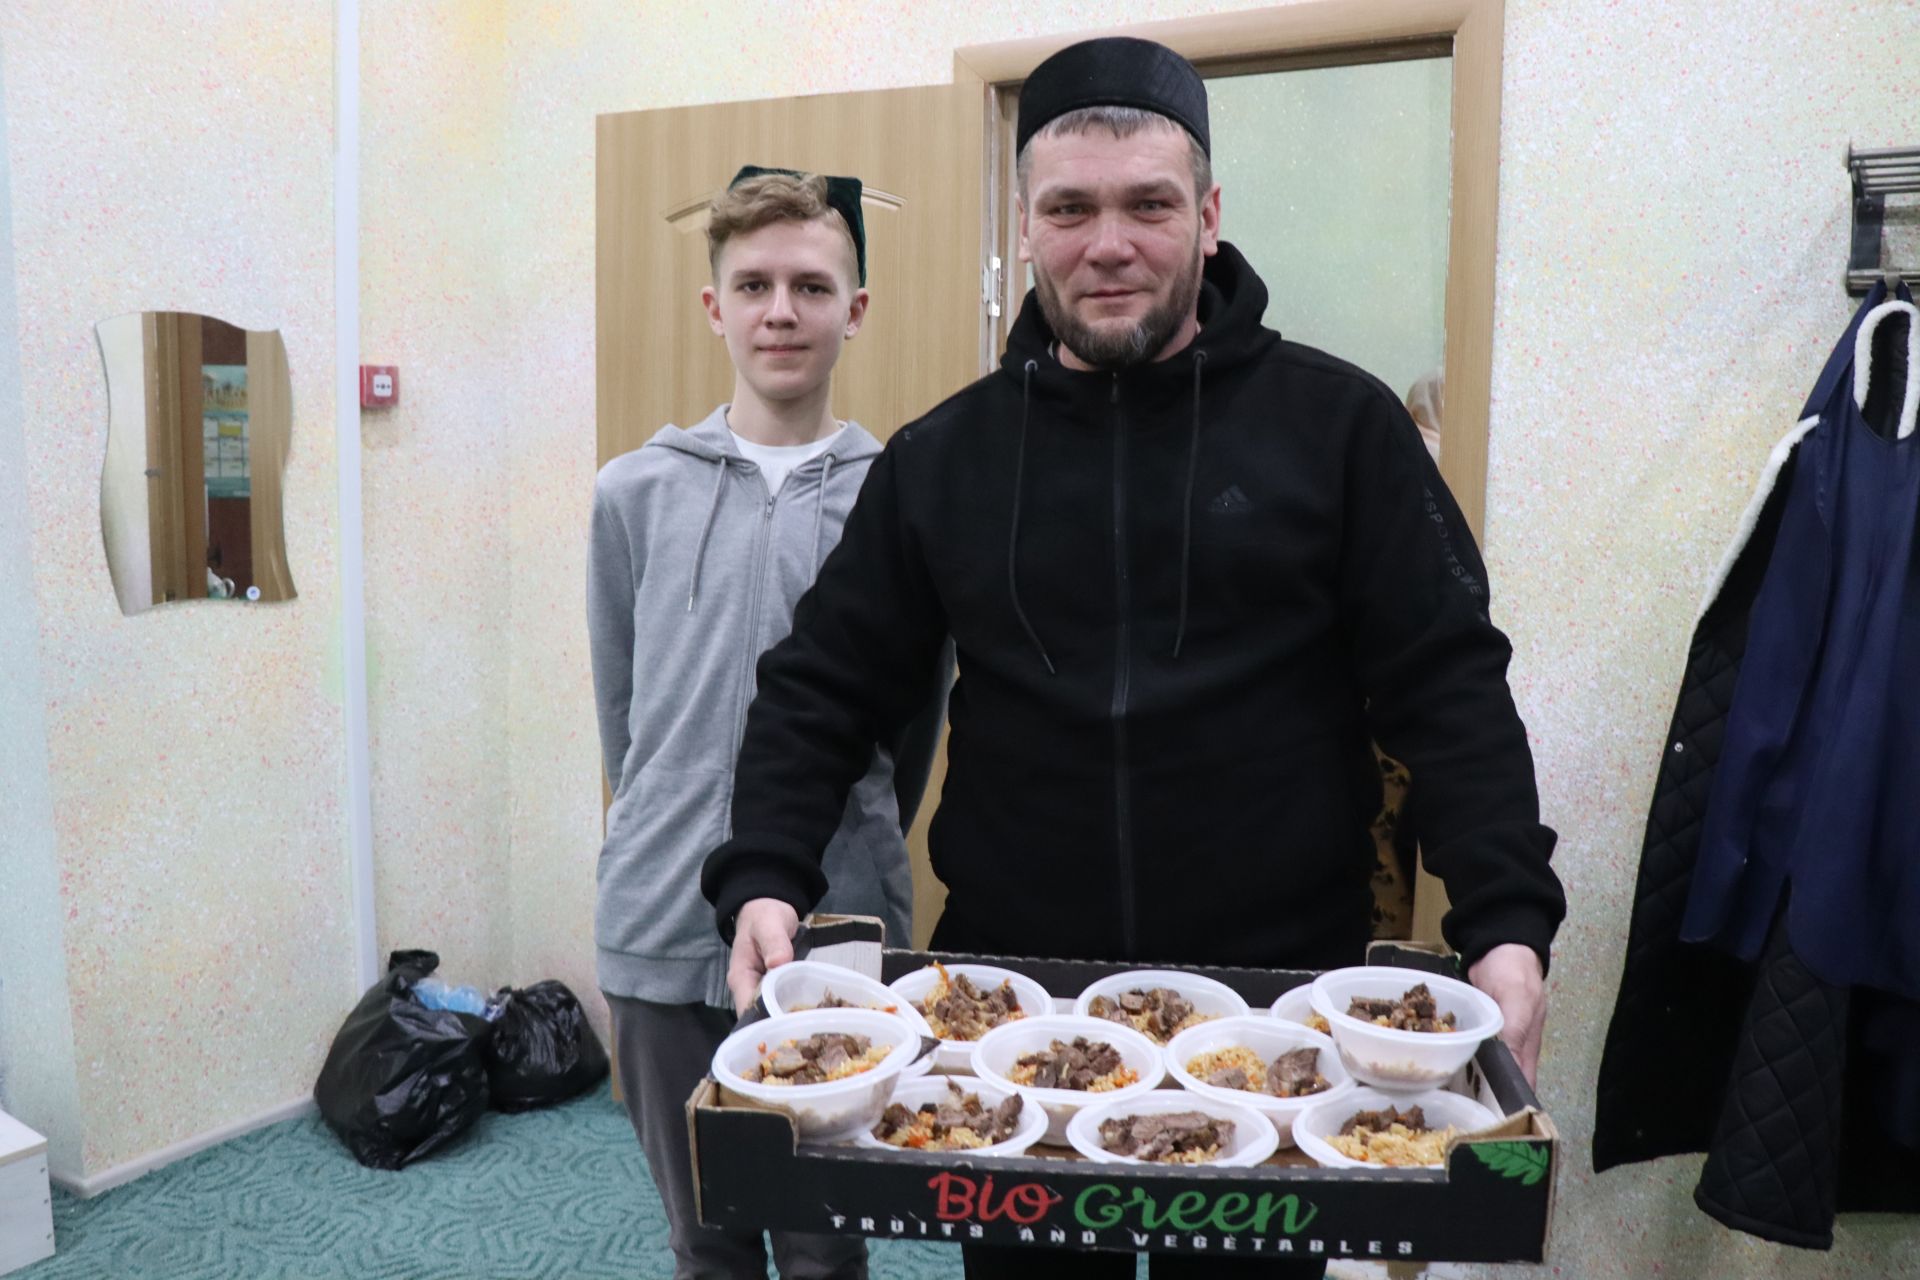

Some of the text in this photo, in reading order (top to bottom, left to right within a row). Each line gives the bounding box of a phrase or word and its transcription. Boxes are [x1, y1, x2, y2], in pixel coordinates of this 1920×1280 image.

[927, 1171, 1318, 1234] Bio Green
[831, 1214, 1413, 1255] FRUITS AND VEGETABLES
